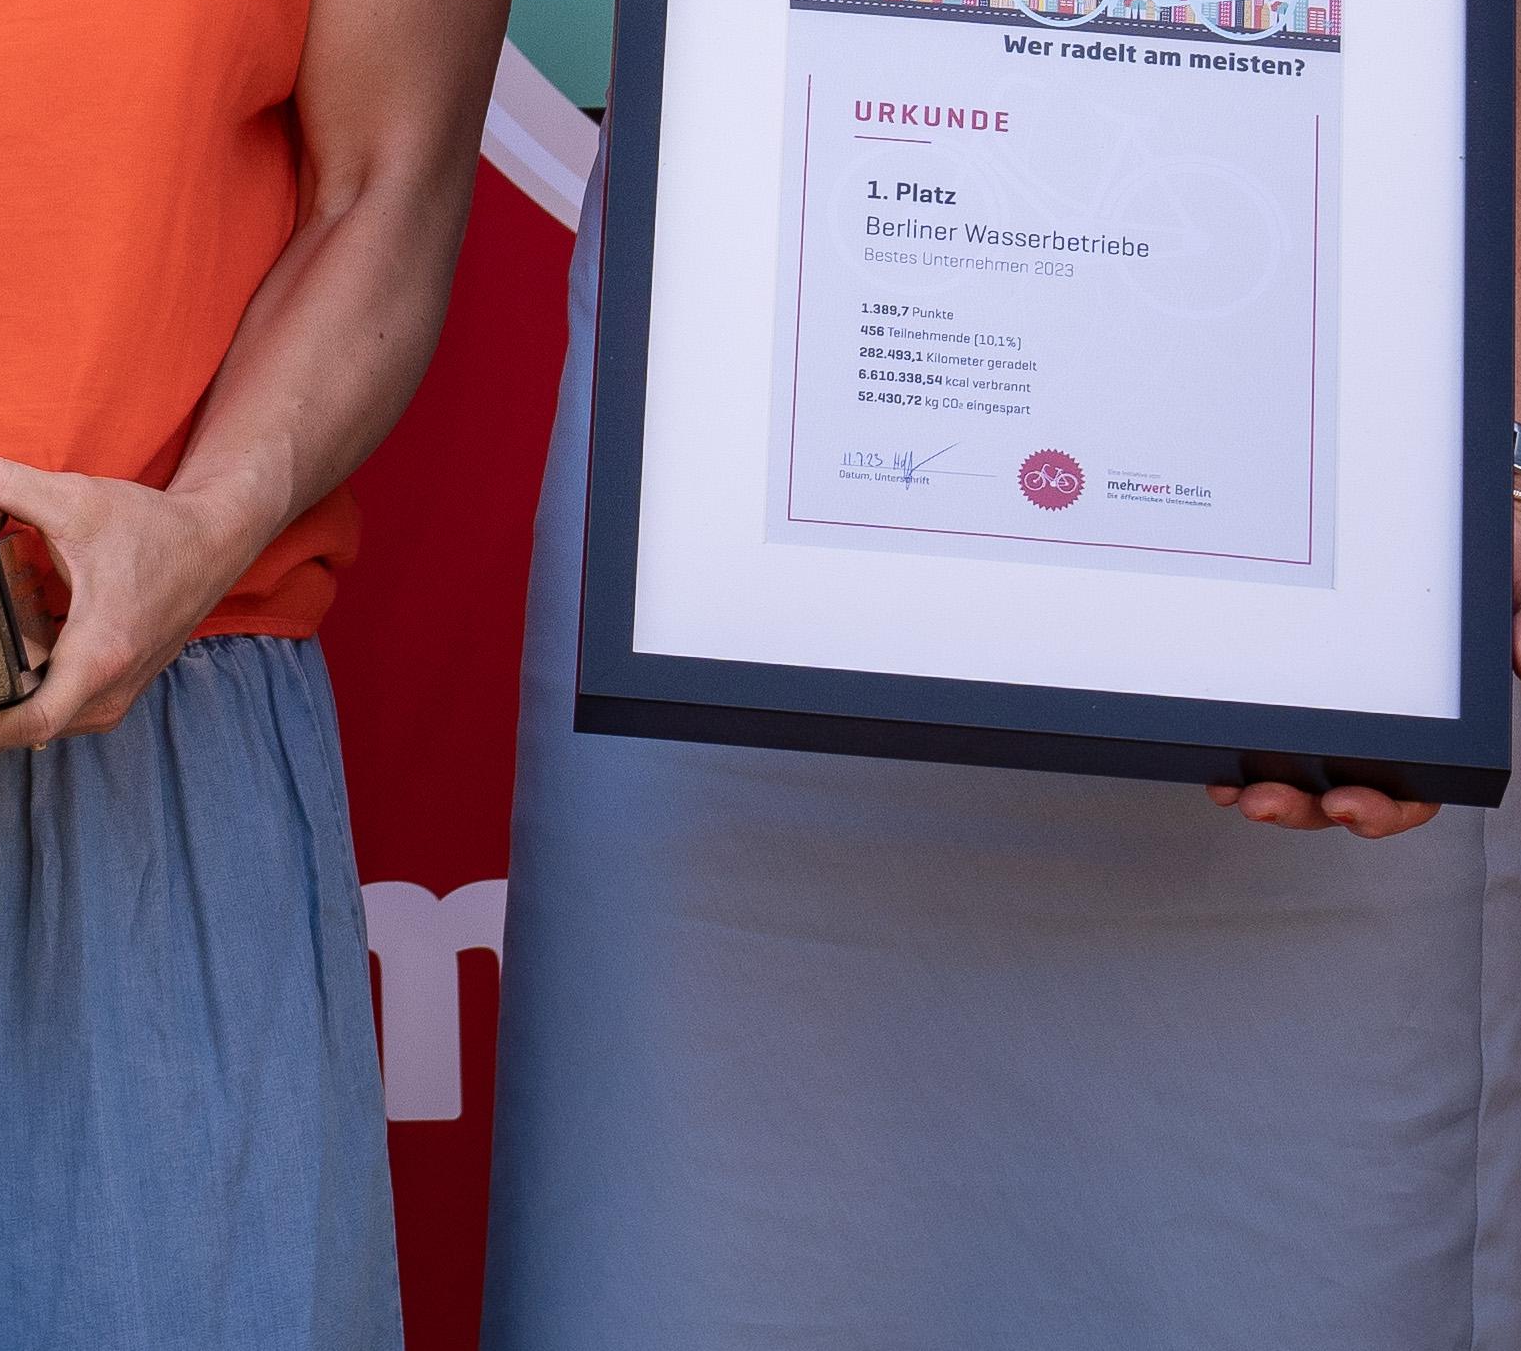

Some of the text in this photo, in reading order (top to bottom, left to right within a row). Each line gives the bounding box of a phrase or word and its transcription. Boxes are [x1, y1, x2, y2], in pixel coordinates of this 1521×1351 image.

[1004, 34, 1305, 77] Wer radelt am meisten?
[854, 101, 1010, 132] URKUNDE
[866, 180, 957, 206] 1. Platz
[866, 216, 1150, 257] Berliner Wasserbetriebe
[864, 248, 1074, 277] Bestes Unternehmen 2023
[861, 303, 954, 320] 1.389,7 Punkte
[861, 326, 884, 336] 456
[888, 327, 970, 343] Teilnehmende
[859, 347, 1037, 371] 282.493,1 Kilometer geradelt
[859, 369, 1030, 392] 6.610.338,54 kcal verbrannt
[858, 391, 922, 406] 52.430,72
[925, 396, 939, 409] kg
[967, 401, 1030, 415] eingespart
[839, 470, 929, 485] Datum, Unterschrift
[1108, 479, 1211, 498] mehrwert Berlin
[1166, 498, 1212, 507] Unternehmen
